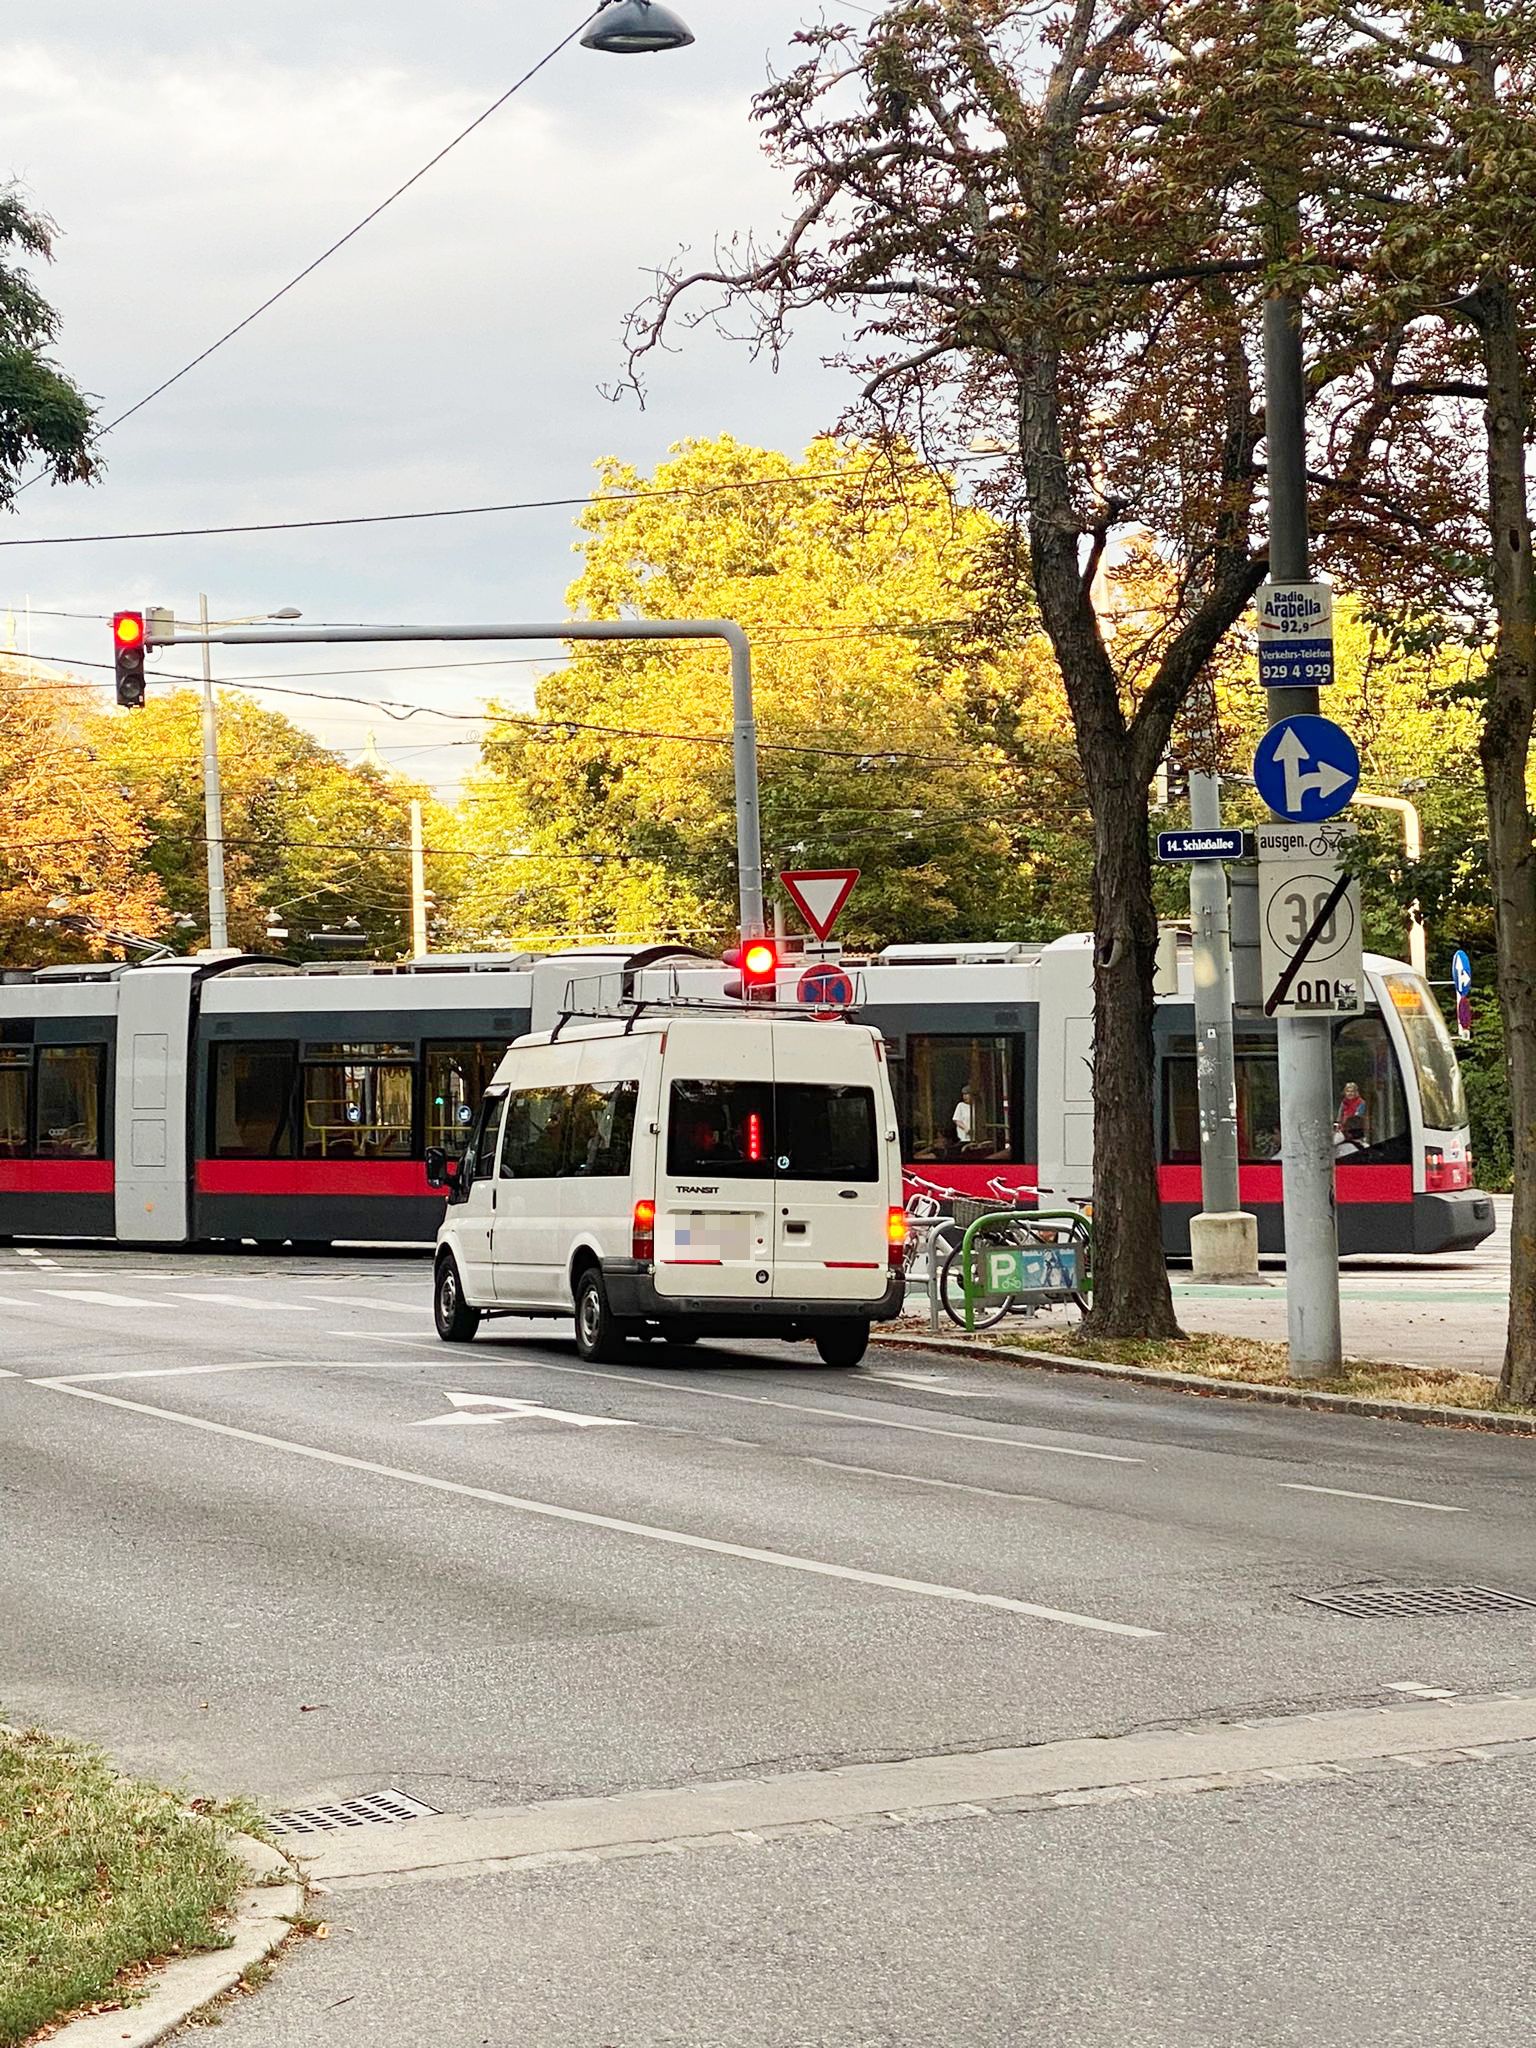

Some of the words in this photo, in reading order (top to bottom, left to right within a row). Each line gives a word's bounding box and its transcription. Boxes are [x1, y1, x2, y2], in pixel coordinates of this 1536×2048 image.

[1274, 591, 1304, 603] Radio
[1264, 599, 1321, 618] Arabella
[1281, 620, 1310, 634] 92,9
[1261, 648, 1331, 660] Verkehrs-Telefon
[1262, 665, 1288, 679] 929
[1292, 664, 1301, 678] 4
[1305, 663, 1331, 677] 929
[1183, 837, 1234, 851] Schloßallee
[1260, 834, 1309, 852] ausgen.
[1284, 892, 1337, 946] 30
[676, 1185, 719, 1194] TRANSIT
[990, 1253, 1017, 1289] P
